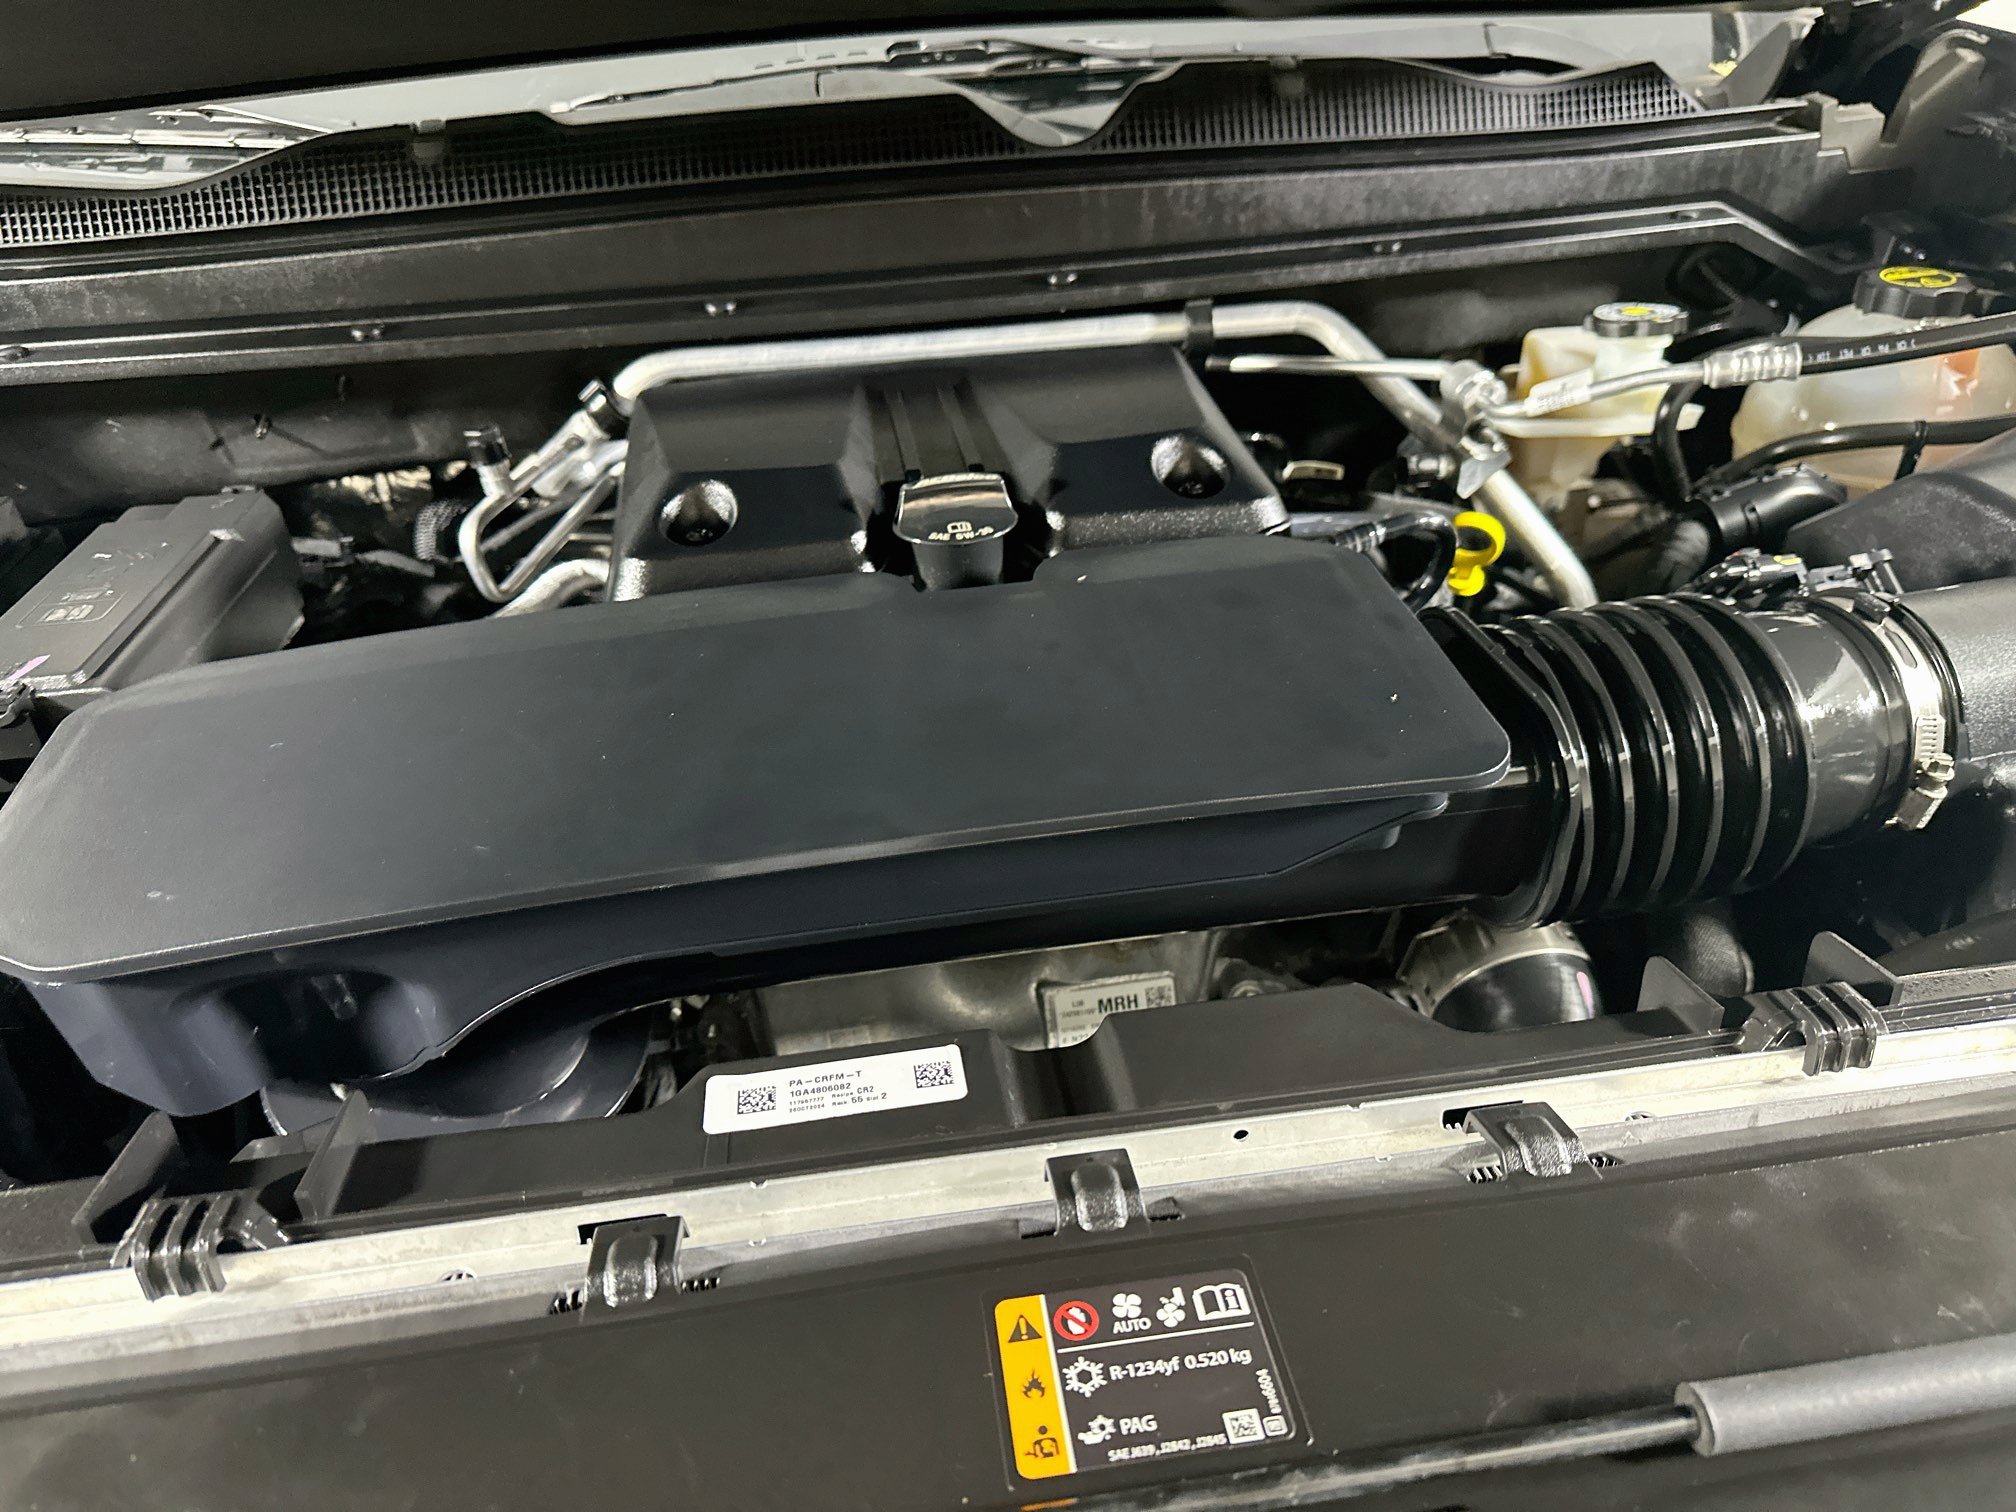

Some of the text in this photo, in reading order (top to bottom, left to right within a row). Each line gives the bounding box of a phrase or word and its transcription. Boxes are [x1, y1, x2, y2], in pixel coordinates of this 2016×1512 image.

[928, 531, 951, 541] SAE
[1097, 993, 1139, 1014] MRH
[851, 1095, 864, 1104] 55
[881, 1092, 887, 1100] 2
[856, 1085, 874, 1094] CR2
[1112, 1318, 1152, 1335] AUTO
[1109, 1347, 1253, 1381] R-1234yf 0.520 kg
[1119, 1414, 1158, 1436] PAG
